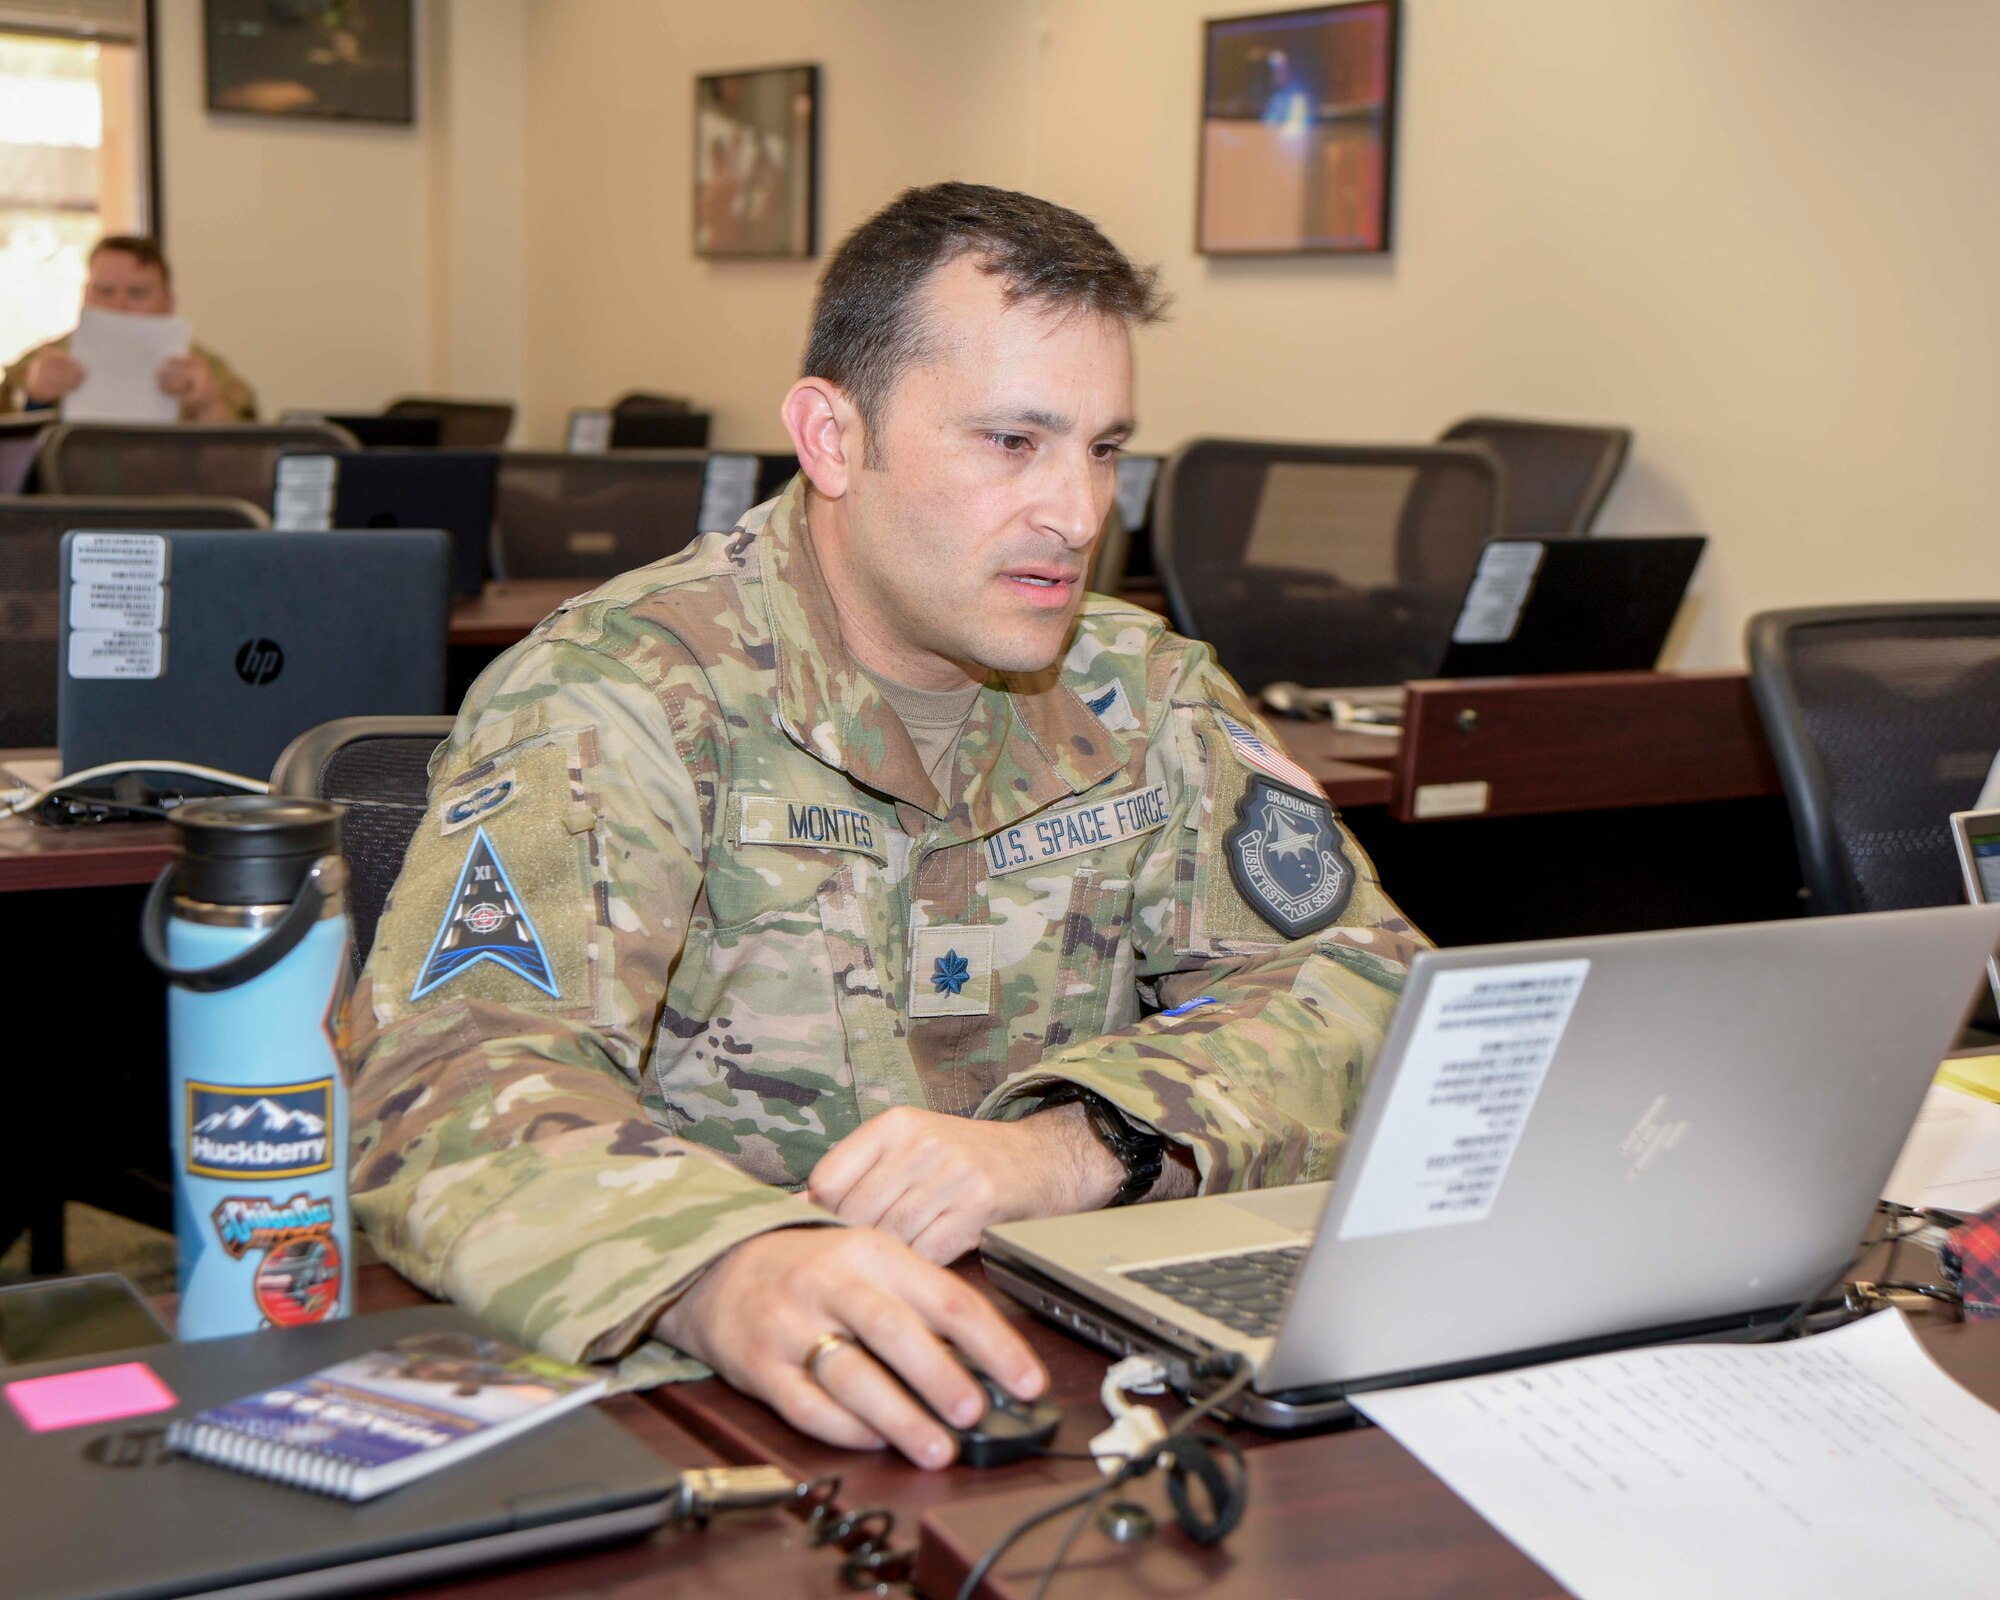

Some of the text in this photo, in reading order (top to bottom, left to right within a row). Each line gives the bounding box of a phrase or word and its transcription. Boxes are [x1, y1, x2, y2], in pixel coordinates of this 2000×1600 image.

[241, 639, 280, 686] hp
[787, 803, 874, 849] MONTES
[1266, 789, 1318, 818] GRADUATE
[988, 787, 1169, 870] U.S. SPACE FORCE
[474, 864, 491, 881] XI
[1245, 849, 1339, 919] USAF TEST PILOT SCHOOL
[192, 1135, 326, 1165] Huckberry
